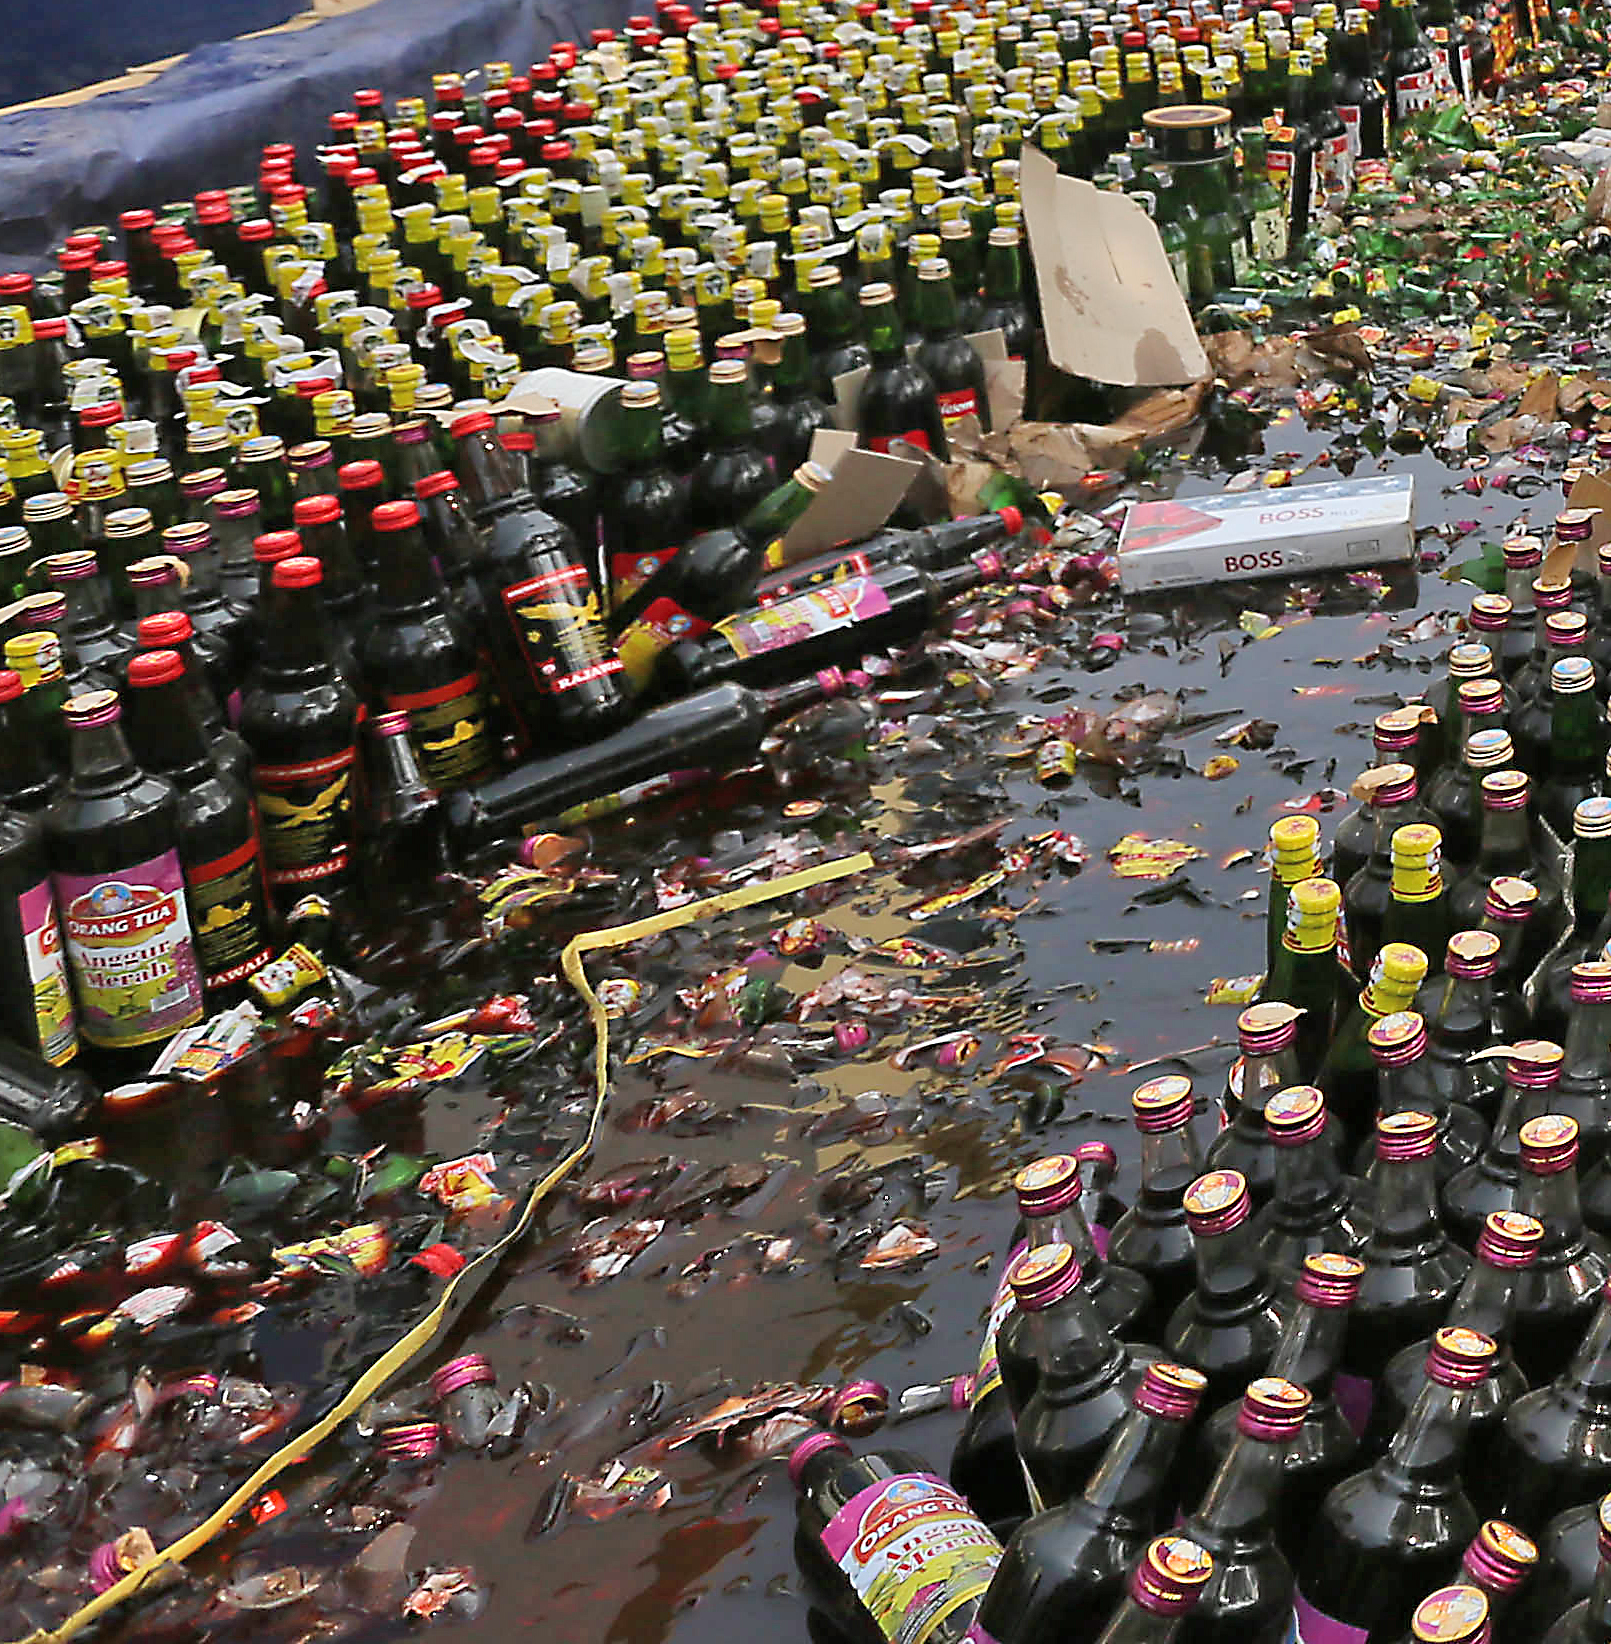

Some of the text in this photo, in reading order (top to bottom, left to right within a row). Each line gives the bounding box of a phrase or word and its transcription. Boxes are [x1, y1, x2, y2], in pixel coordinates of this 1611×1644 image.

[1260, 507, 1325, 525] BOSS
[1224, 550, 1284, 573] BOSS
[133, 906, 172, 929] TUA
[859, 1502, 939, 1554] ORANG
